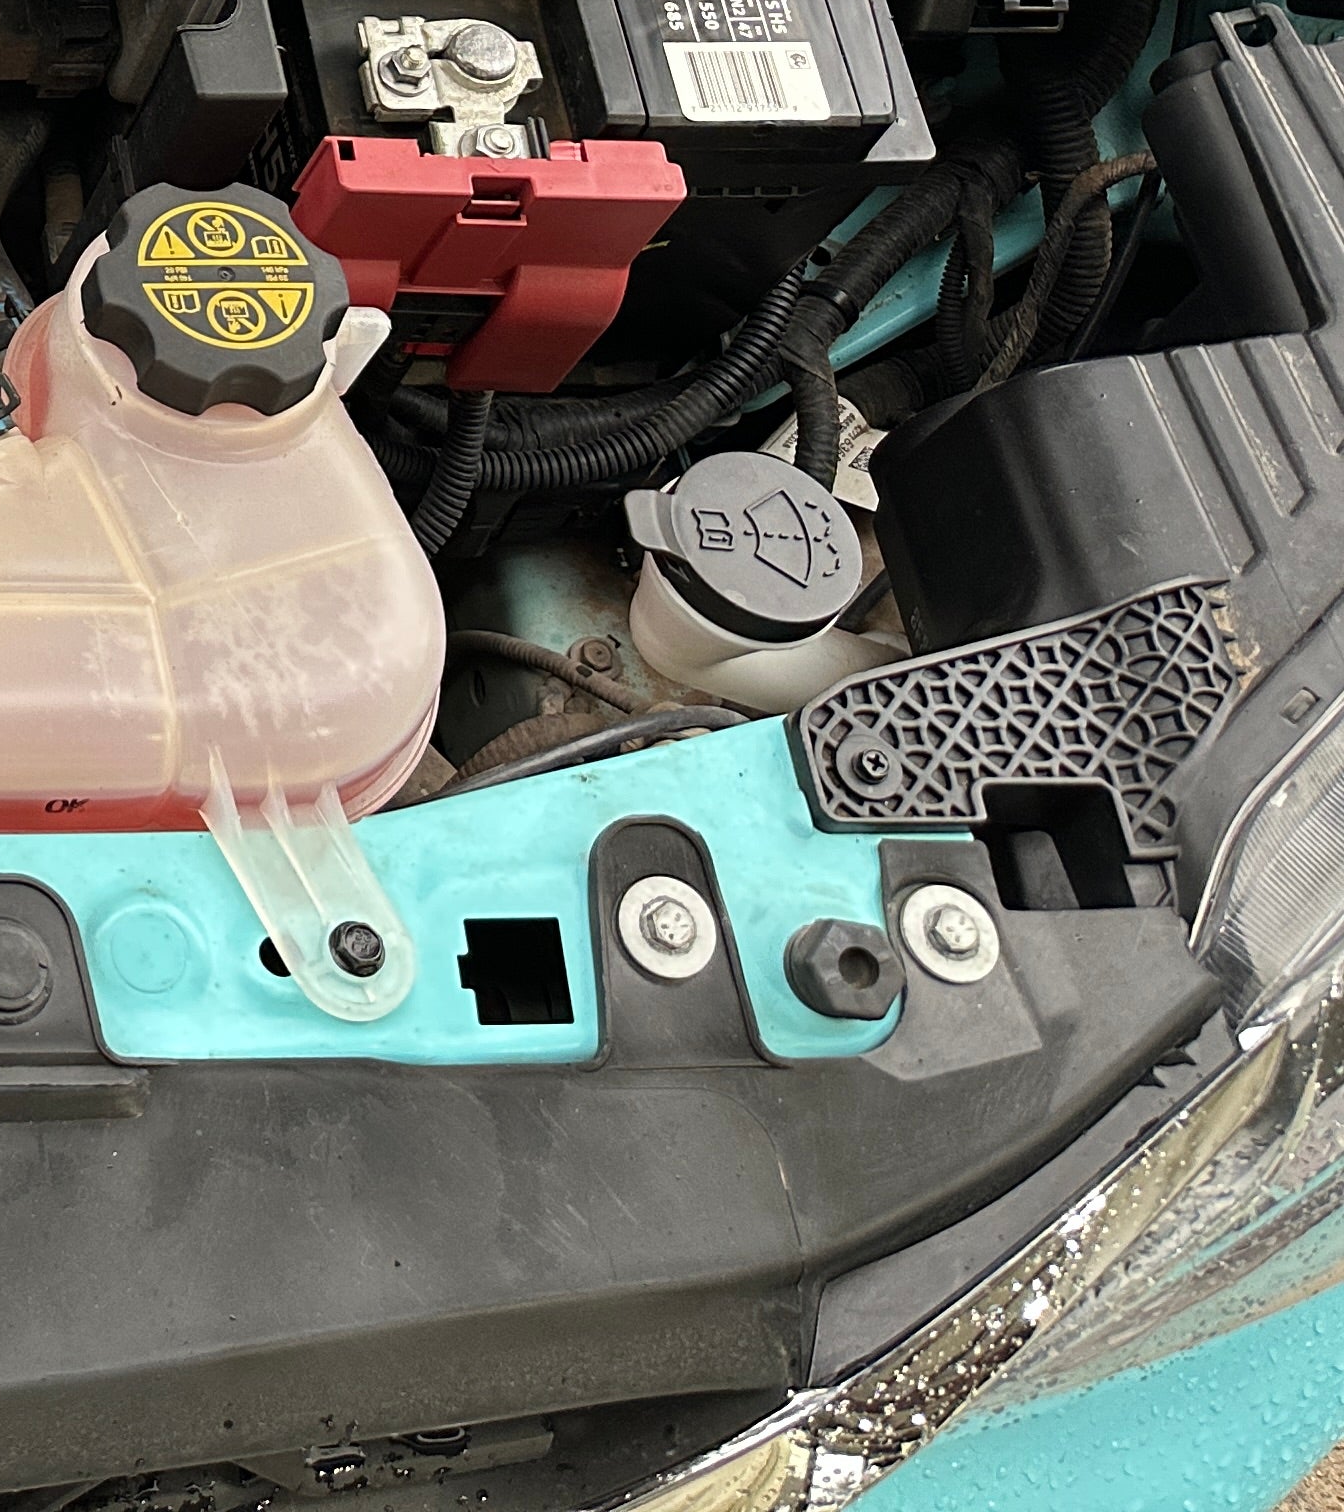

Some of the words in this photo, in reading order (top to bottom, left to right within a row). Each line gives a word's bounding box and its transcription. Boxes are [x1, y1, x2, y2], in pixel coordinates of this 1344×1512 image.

[663, 1, 686, 31] 685
[697, 1, 721, 30] 550
[767, 12, 790, 34] H5
[735, 21, 755, 38] 47
